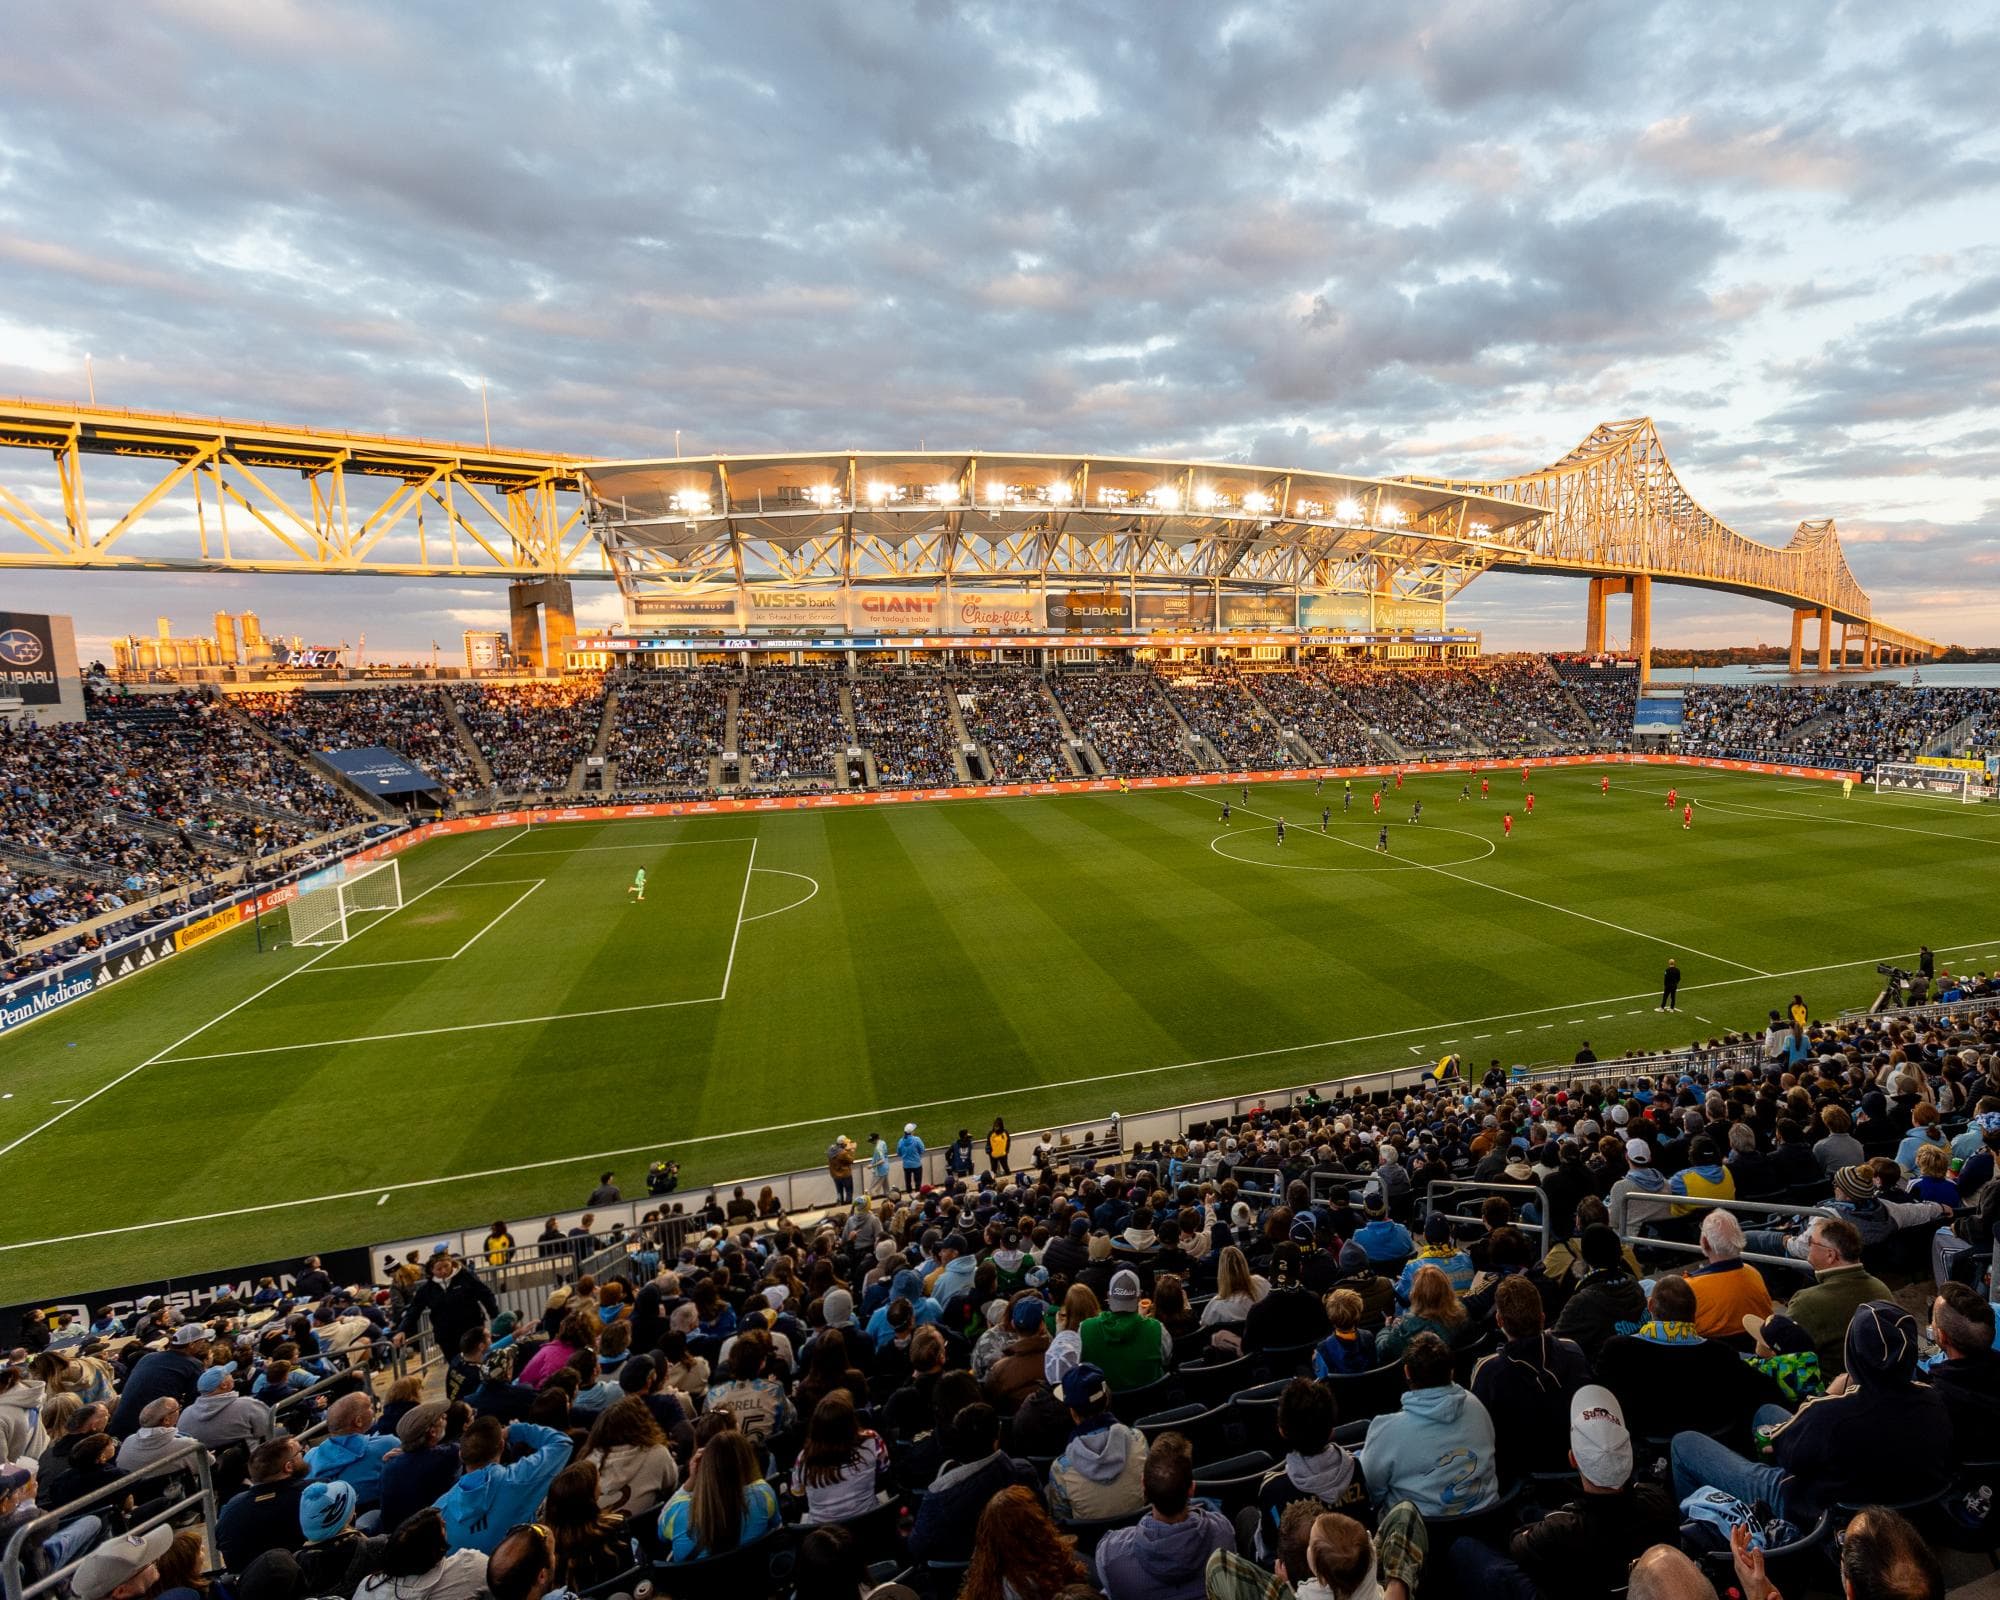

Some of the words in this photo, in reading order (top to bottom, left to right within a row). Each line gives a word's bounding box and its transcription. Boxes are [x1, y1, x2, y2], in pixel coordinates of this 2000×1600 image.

[752, 593, 807, 608] WSFS
[809, 597, 835, 608] bank
[862, 597, 937, 613] GIANT
[961, 601, 1033, 626] Chick-fil-A
[1072, 607, 1128, 616] SUBARU
[1301, 606, 1358, 617] Independence
[1395, 608, 1441, 618] NEMOURS
[882, 615, 910, 624] today's
[182, 919, 217, 946] Continental
[222, 911, 236, 925] Tire
[0, 1004, 34, 1029] Penn
[33, 978, 93, 1015] Medicine
